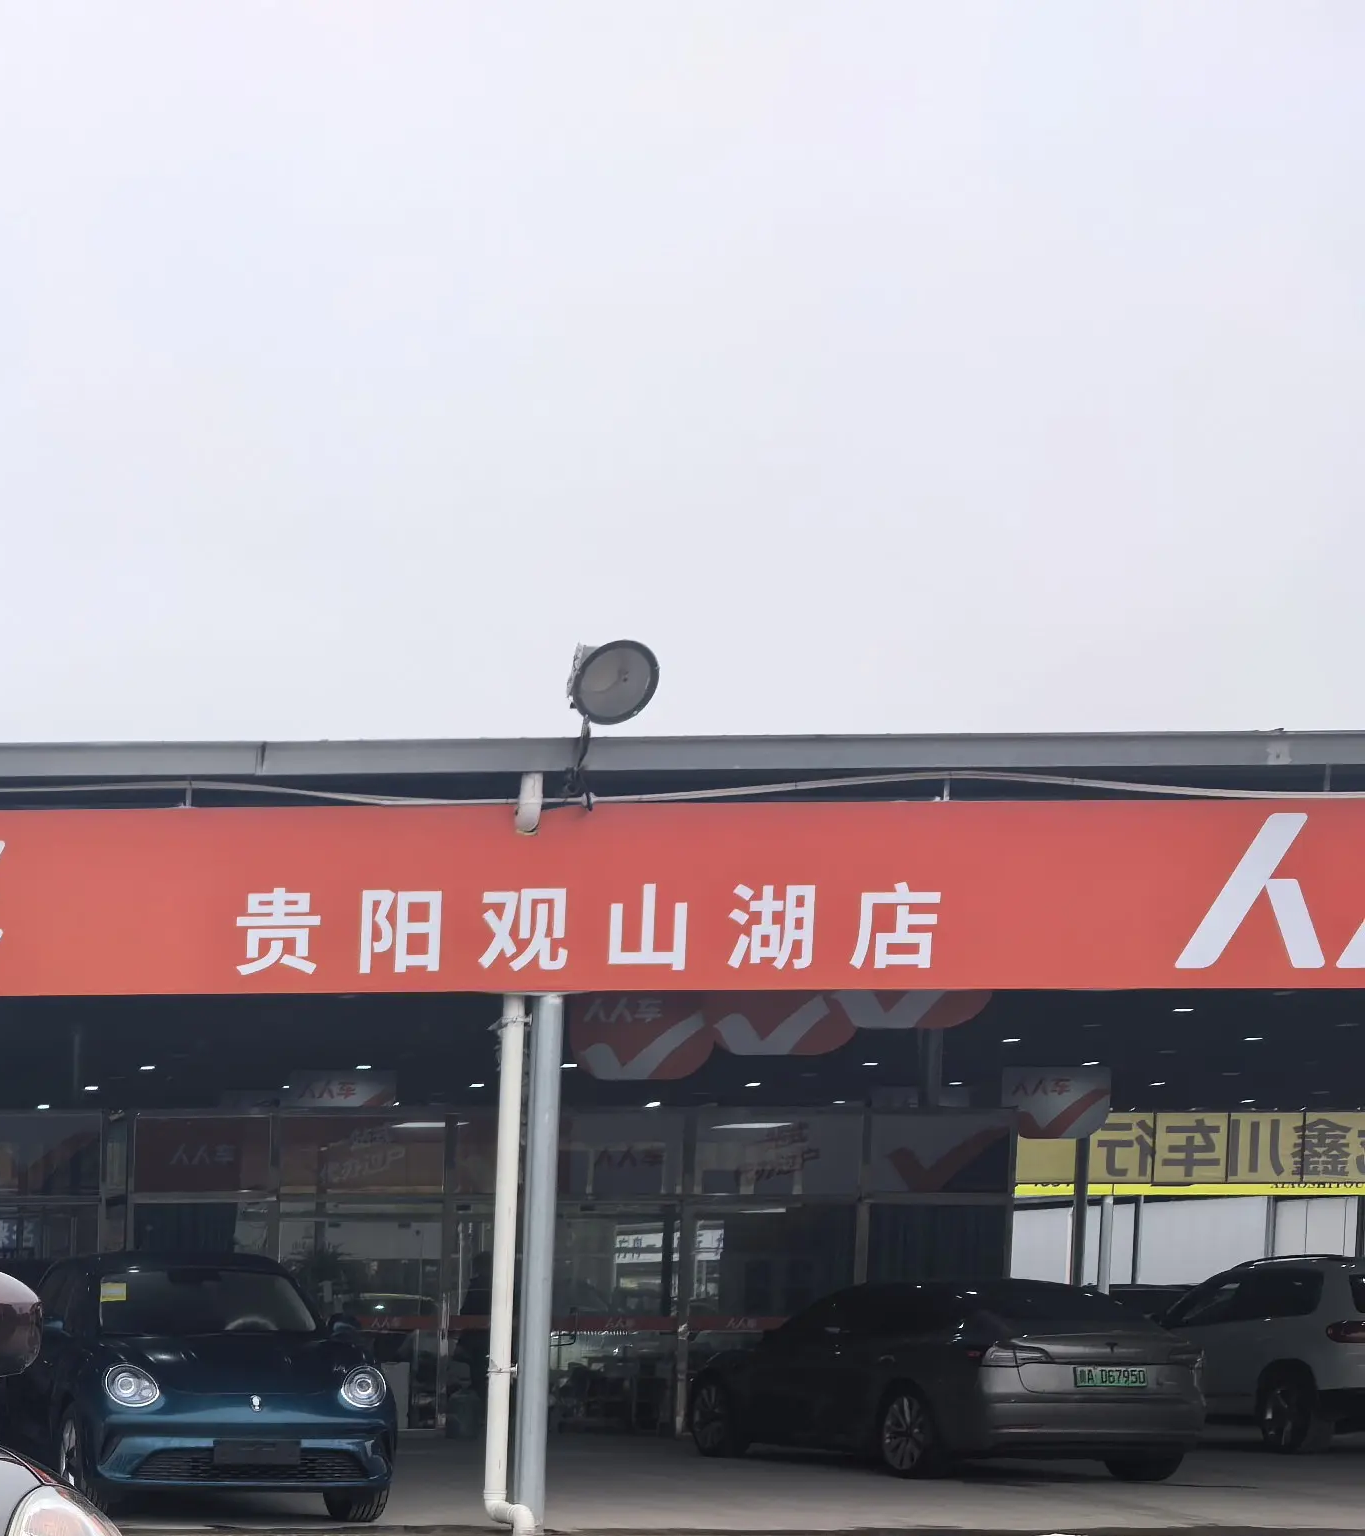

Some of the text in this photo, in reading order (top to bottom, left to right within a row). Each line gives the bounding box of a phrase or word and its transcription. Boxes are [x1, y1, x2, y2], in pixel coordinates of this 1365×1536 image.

[234, 881, 943, 976] 贵阳观山湖店
[1174, 811, 1365, 970] 人
